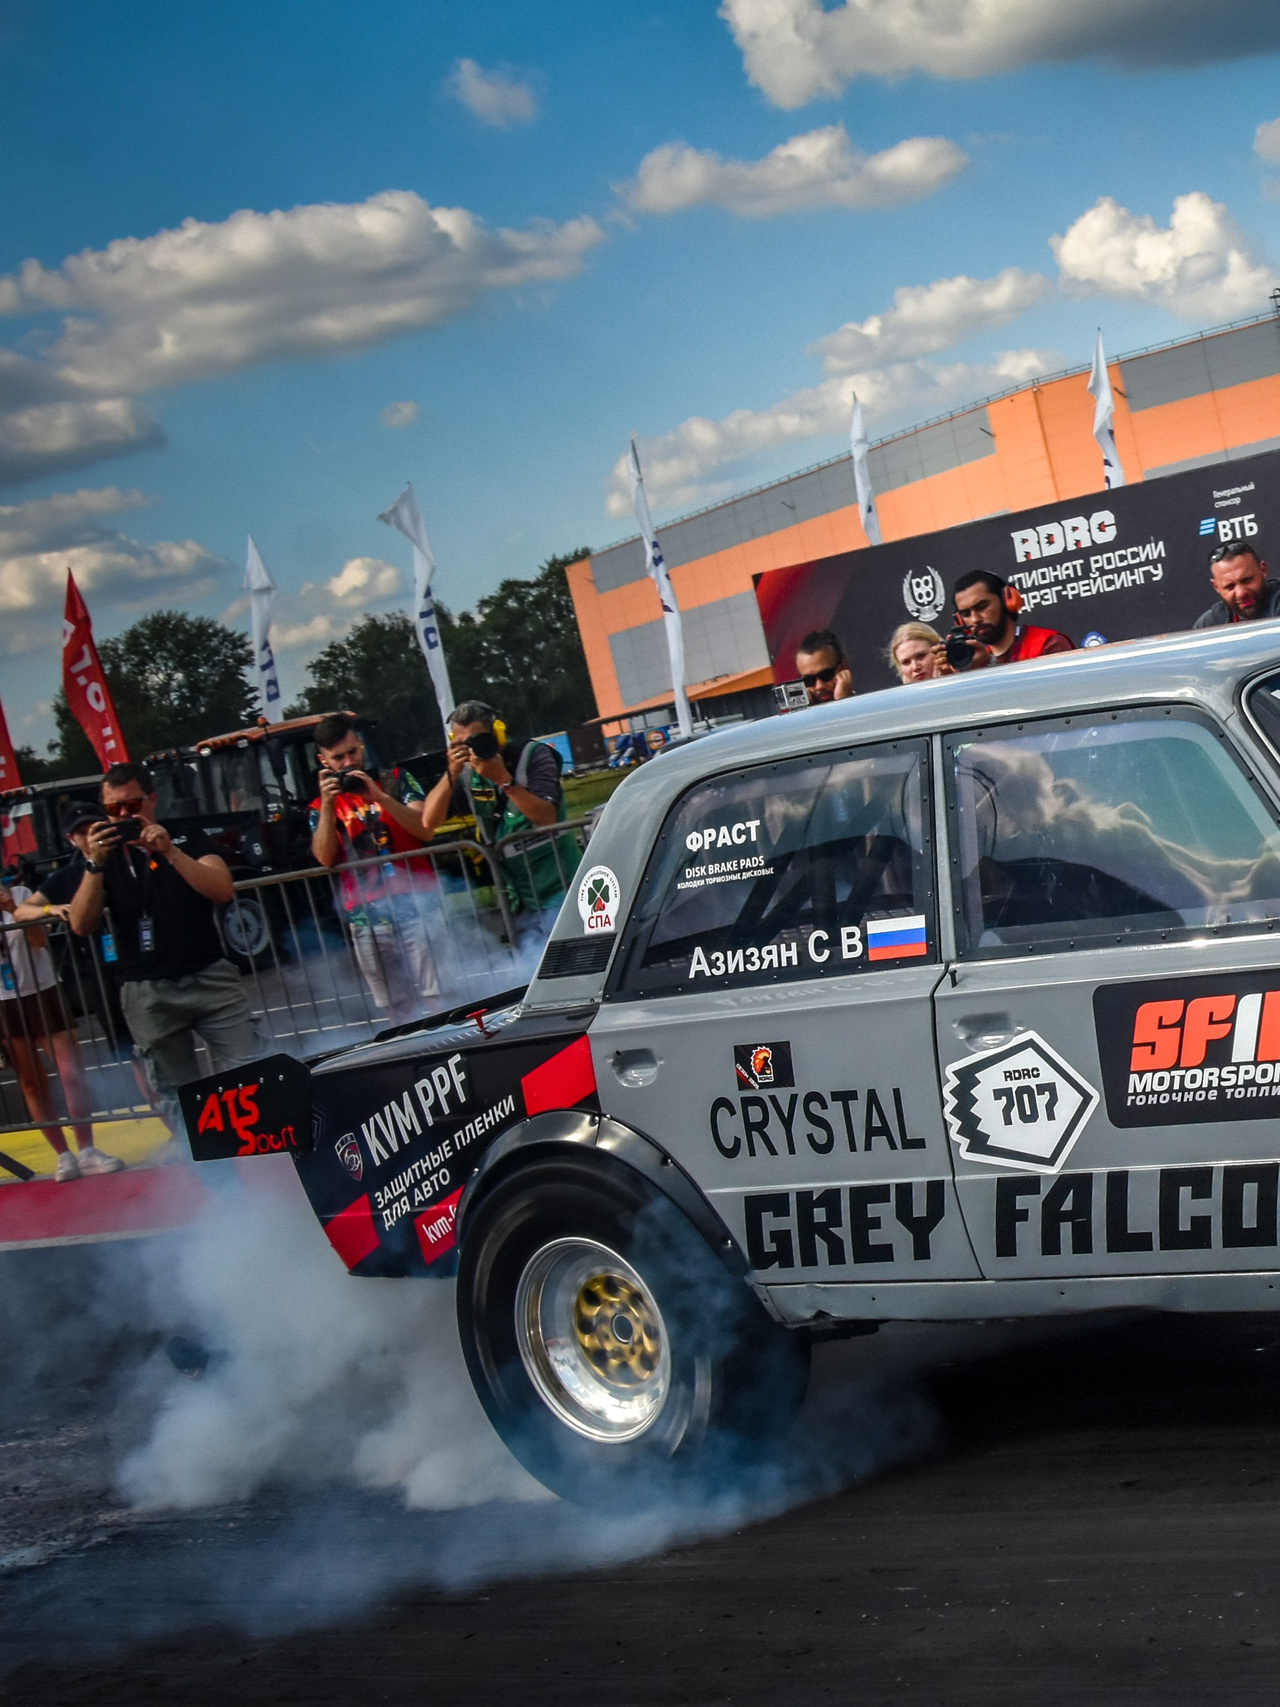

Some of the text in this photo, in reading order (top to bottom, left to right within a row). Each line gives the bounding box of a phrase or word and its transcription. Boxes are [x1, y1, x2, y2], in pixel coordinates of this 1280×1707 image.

[1213, 482, 1255, 498] Генеральный
[1215, 497, 1241, 508] спонсор
[1011, 510, 1117, 563] RDRC
[1218, 514, 1258, 542] ВТБ
[1008, 540, 1166, 590] ПИОНАТ РОССИИ
[686, 820, 760, 852] ФРАСТ
[677, 867, 774, 890] КОЛОДКИ ТОРМОЗНЫЕ ДИСКОВЫЕ
[685, 855, 765, 879] DISK BRAKE PADS
[588, 914, 611, 929] СПА
[688, 926, 863, 979] Азизян С В
[1003, 1067, 1040, 1082] RDRC
[197, 1084, 259, 1135] ATS
[361, 1053, 467, 1167] KVM PPF
[709, 1087, 927, 1160] CRYSTAL
[993, 1081, 1059, 1126] 707
[374, 1094, 516, 1209] ЗАЩИТНЫЕ ПЛЕНКИ
[382, 1168, 450, 1231] ДЛЯ АВТО
[744, 1180, 946, 1271] GREY
